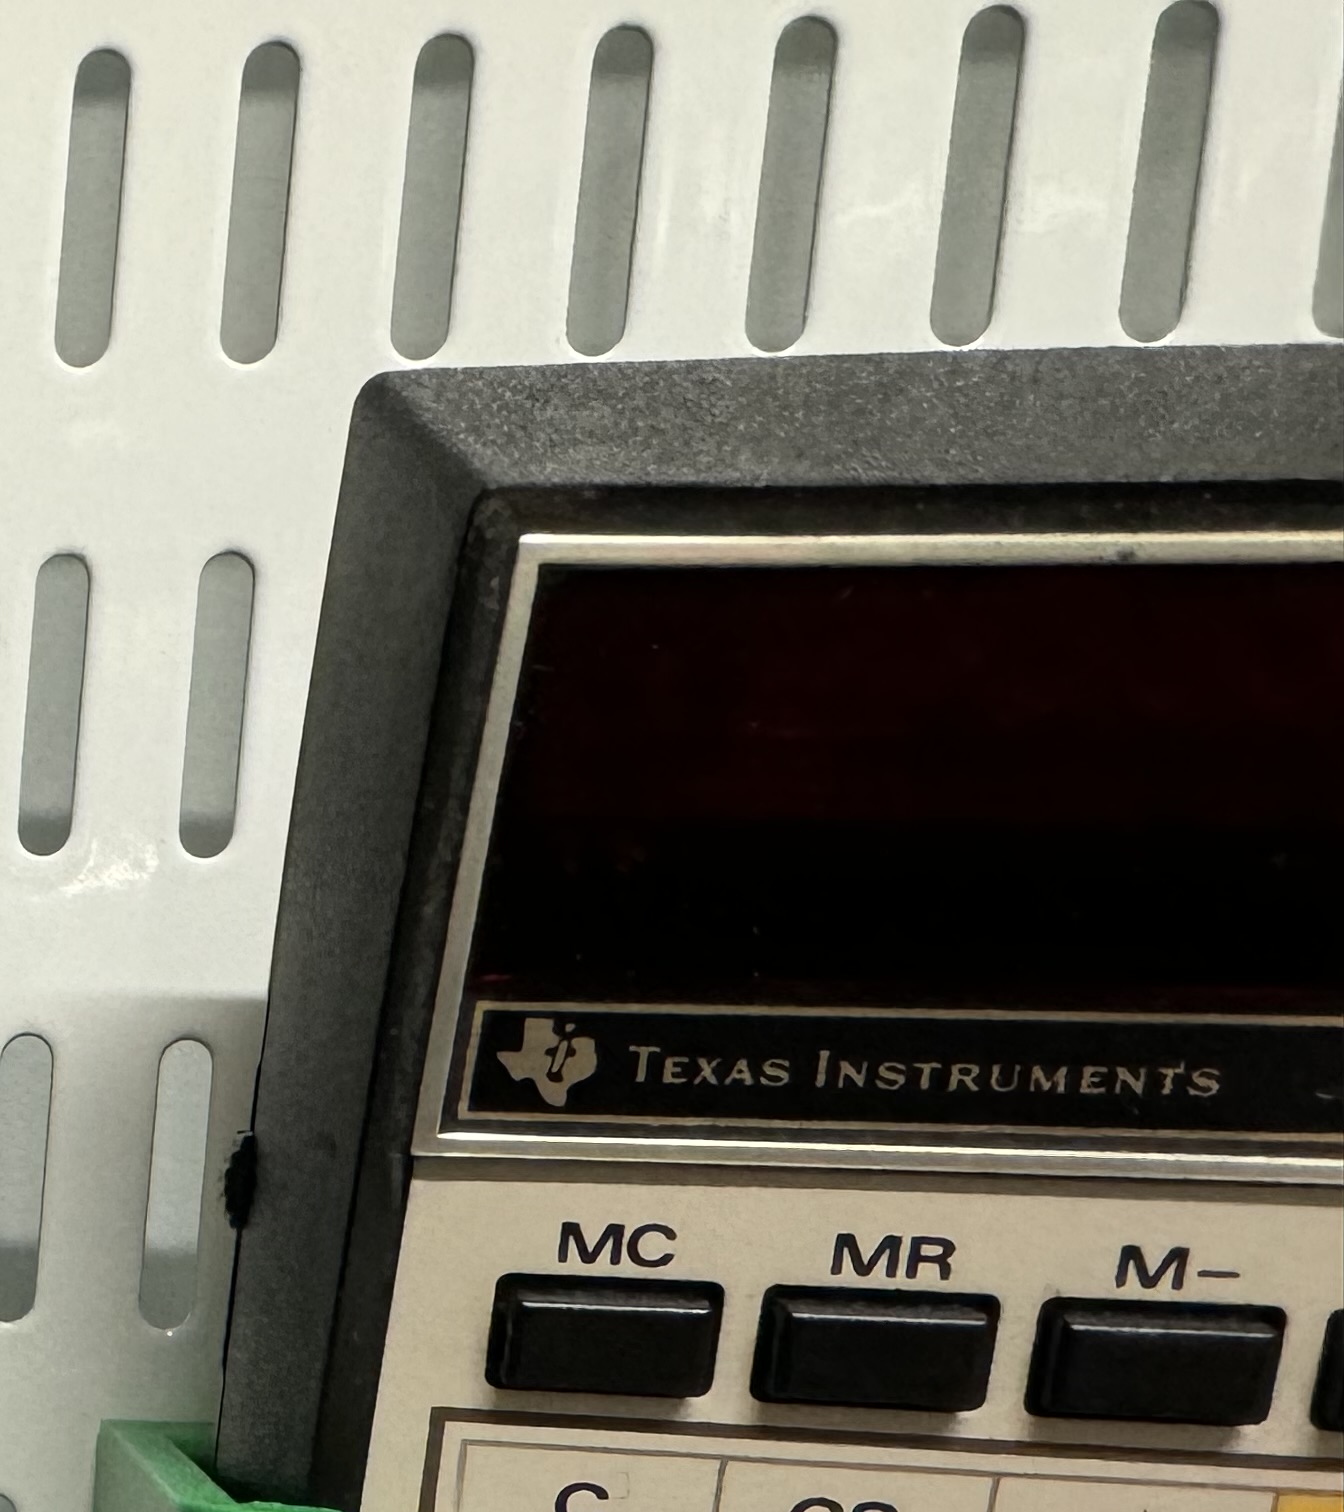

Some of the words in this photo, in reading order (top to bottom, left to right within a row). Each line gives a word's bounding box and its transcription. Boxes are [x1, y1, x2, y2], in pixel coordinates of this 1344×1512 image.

[628, 1044, 790, 1088] TEXAS
[815, 1049, 1221, 1098] INSTRUMENTS
[557, 1220, 678, 1268] MC
[829, 1232, 957, 1281] MR
